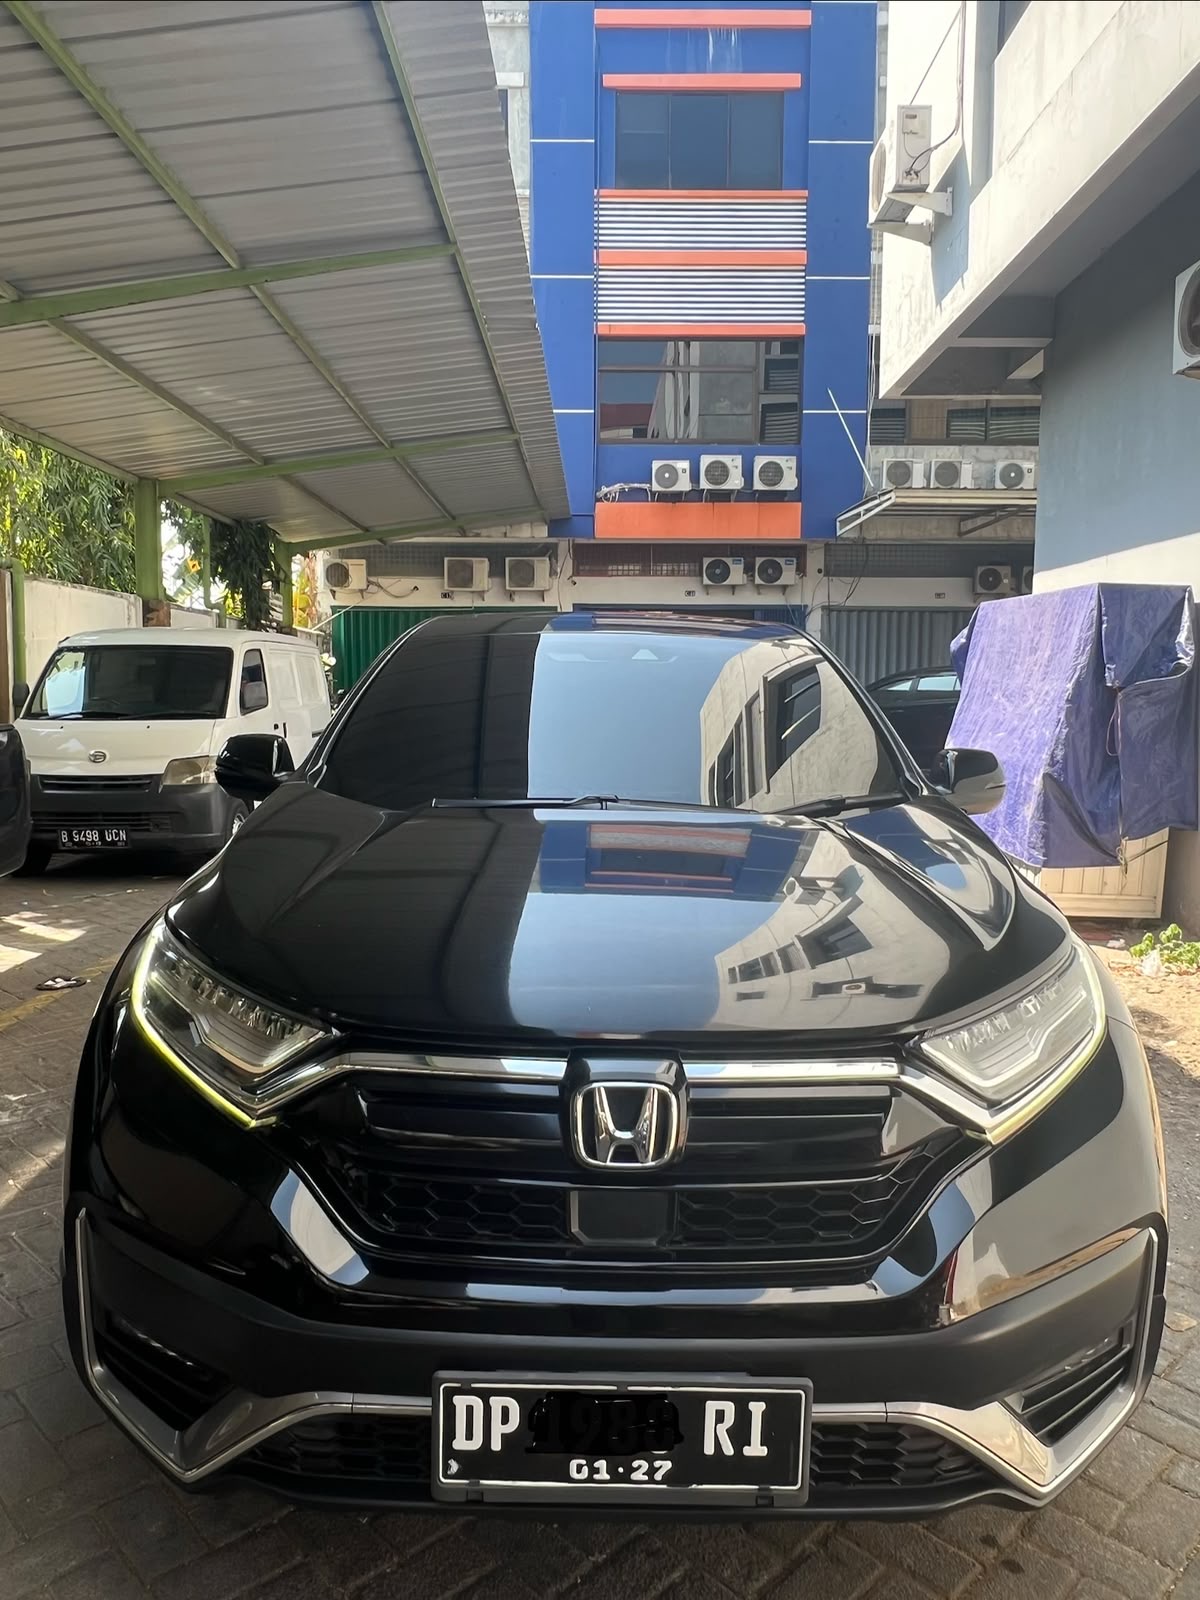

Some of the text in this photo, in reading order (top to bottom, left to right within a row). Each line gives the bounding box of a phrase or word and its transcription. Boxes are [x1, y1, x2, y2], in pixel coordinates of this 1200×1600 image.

[61, 830, 68, 842] B
[104, 829, 127, 841] UCN
[452, 1395, 520, 1452] DP
[703, 1399, 768, 1457] RI
